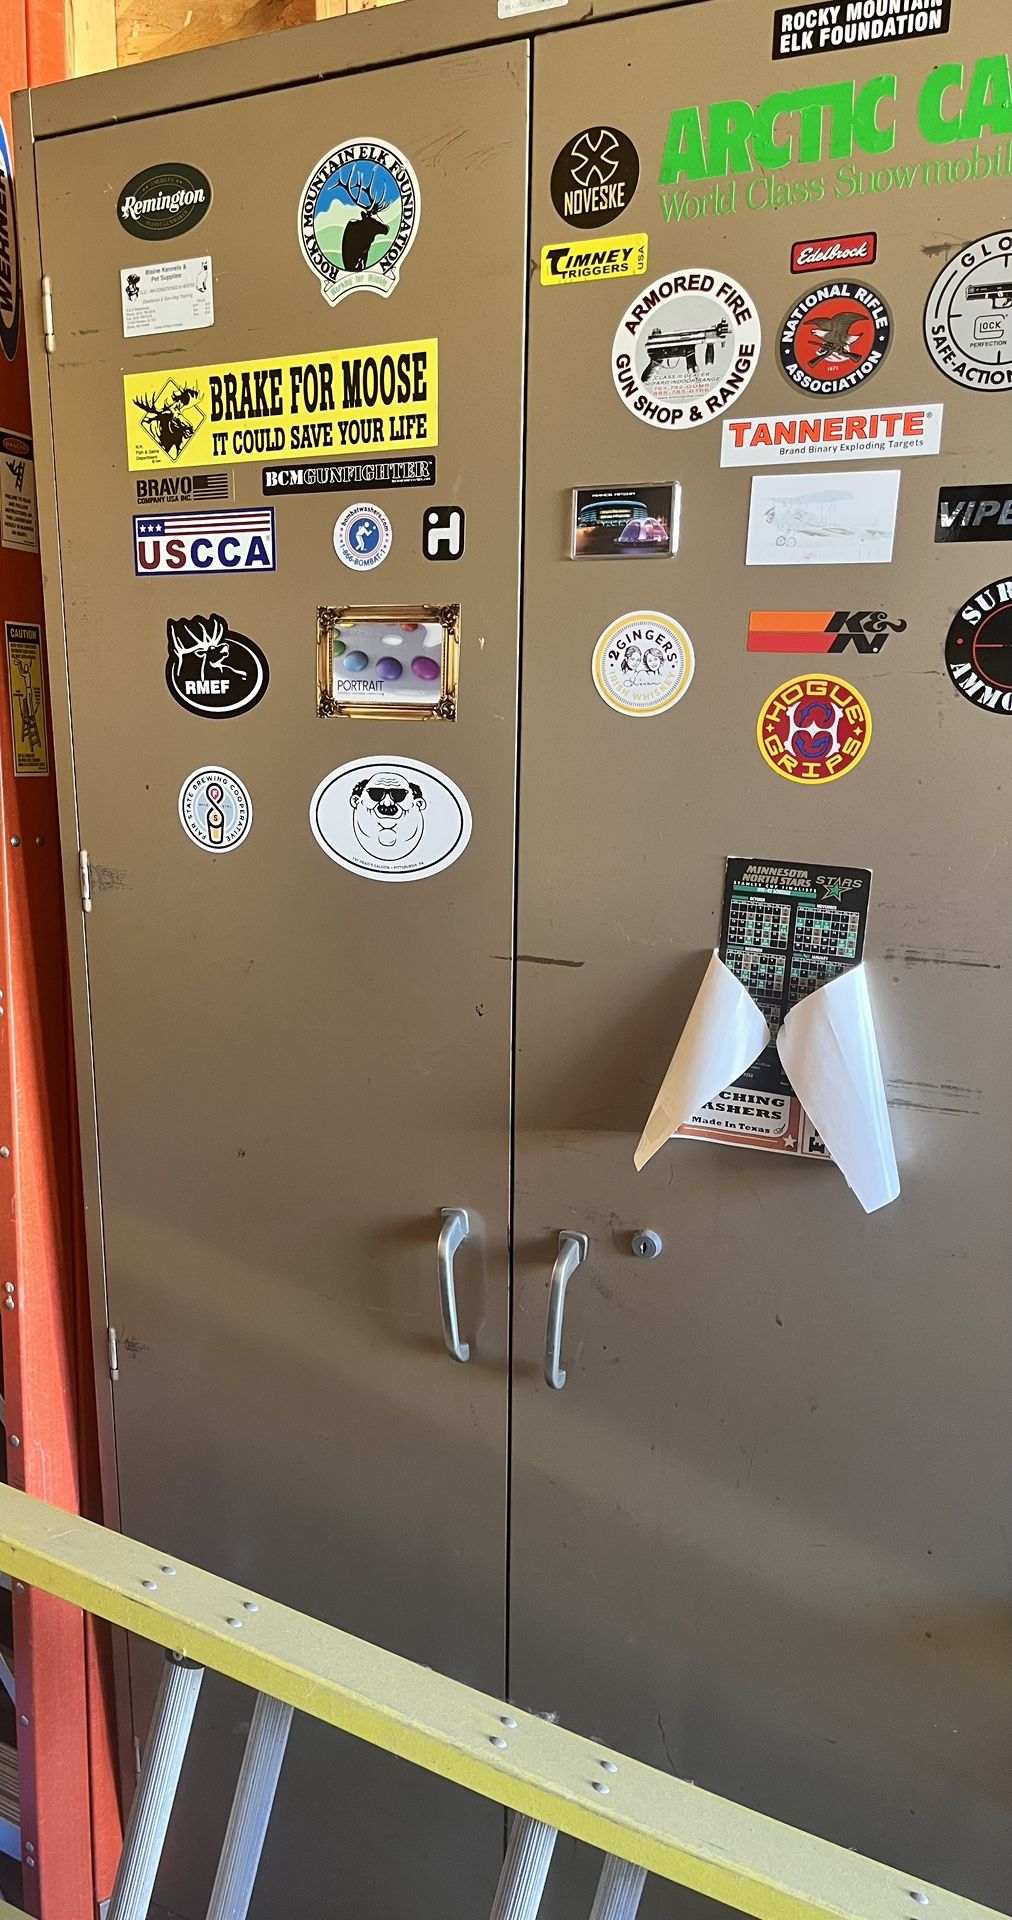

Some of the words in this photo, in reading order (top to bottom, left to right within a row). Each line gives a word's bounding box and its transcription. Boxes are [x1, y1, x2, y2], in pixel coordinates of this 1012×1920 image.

[780, 30, 814, 54] ELK
[819, 8, 943, 48] FOUNDATION
[781, 5, 841, 33] ROCKY
[657, 73, 897, 186] ARCTIC
[916, 53, 1012, 145] CA
[358, 146, 391, 165] ELK
[304, 149, 355, 228] MOUNTAIN
[658, 180, 736, 224] World
[746, 174, 825, 211] Class
[834, 143, 1012, 200] Snowmobil
[121, 188, 206, 220] Remington
[564, 182, 626, 217] NOVESKE
[380, 161, 415, 272] FOUNDATION
[304, 233, 340, 281] ROCKY
[545, 247, 633, 276] TIMNEY
[637, 245, 645, 270] USA
[796, 241, 869, 266] Edelbrock
[960, 236, 1012, 268] GLO
[160, 273, 182, 281] Supplies
[561, 262, 629, 280] TRIGGERS
[625, 274, 715, 337] ARMORED
[715, 281, 752, 326] FIRE
[781, 283, 851, 343] NATIONAL
[853, 287, 889, 329] RIFLE
[969, 340, 1007, 349] PERFECTION
[616, 353, 639, 398] GUN
[633, 395, 684, 425] SHOP
[689, 405, 703, 421] &
[705, 344, 755, 414] RANGE
[785, 350, 882, 393] ASSOCIATION
[208, 368, 284, 422] BRAKE
[290, 362, 336, 414] FOR
[341, 351, 428, 408] MOOSE
[212, 432, 229, 457] IT
[232, 426, 286, 455] COULD
[290, 421, 334, 450] SAVE
[337, 416, 385, 445] YOUR
[389, 412, 428, 441] LIFE
[728, 411, 925, 448] TANNERITE
[779, 445, 806, 456] Brand
[808, 443, 838, 455] Binary
[839, 440, 886, 452] Exploding
[888, 438, 924, 449] Targets
[136, 476, 192, 497] BRAVO
[137, 496, 165, 505] COMPANY
[940, 499, 1012, 528] VIPE
[137, 535, 271, 570] USCCA
[339, 543, 386, 567] 1-866-BOMBAT-1
[961, 581, 1012, 626] SUR
[10, 628, 37, 640] CAUTION
[608, 649, 620, 661] 2
[616, 629, 678, 662] GINGERS
[185, 679, 231, 695] RMEF
[337, 679, 385, 692] PORTRAIT
[608, 671, 630, 697] IRISH
[632, 671, 675, 700] WHISKEY
[765, 680, 865, 724] HOGUE
[764, 733, 862, 778] GRIPS
[192, 775, 228, 790] BREWING
[186, 792, 194, 820] STATE
[213, 814, 218, 822] S
[226, 784, 246, 842] COOPERATIVE
[190, 822, 207, 840] FAIR
[742, 873, 778, 885] NORTH
[780, 876, 812, 888] STARS
[745, 864, 808, 879] MINNESOTA
[815, 875, 863, 888] STARS
[733, 880, 763, 888] STANLEY
[781, 885, 817, 893] FINALISTS
[701, 1101, 782, 1120] ASHERS
[718, 1091, 785, 1108] CHING
[692, 1116, 722, 1127] Made
[725, 1120, 736, 1129] In
[738, 1123, 771, 1134] Texas
